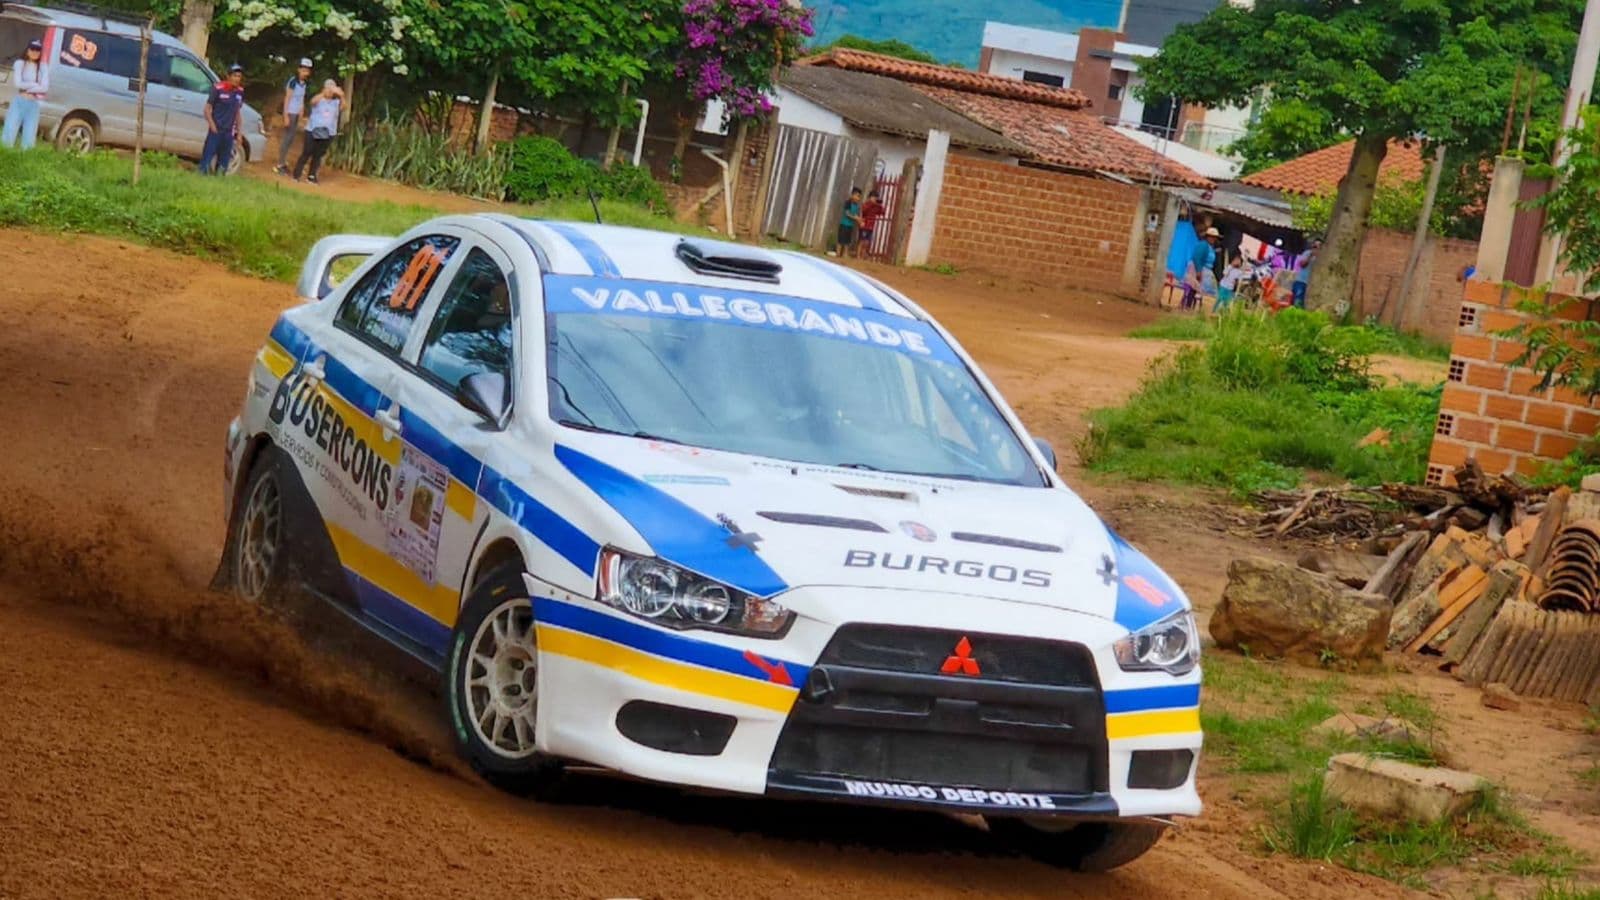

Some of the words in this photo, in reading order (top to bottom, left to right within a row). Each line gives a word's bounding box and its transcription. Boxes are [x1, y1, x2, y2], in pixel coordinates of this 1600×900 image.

[571, 287, 932, 355] VALLEGRANDE
[269, 361, 392, 511] BUSERCONS
[844, 549, 1052, 588] BURGOS
[843, 781, 938, 799] MUNDO
[941, 788, 1056, 809] DEPORTE
